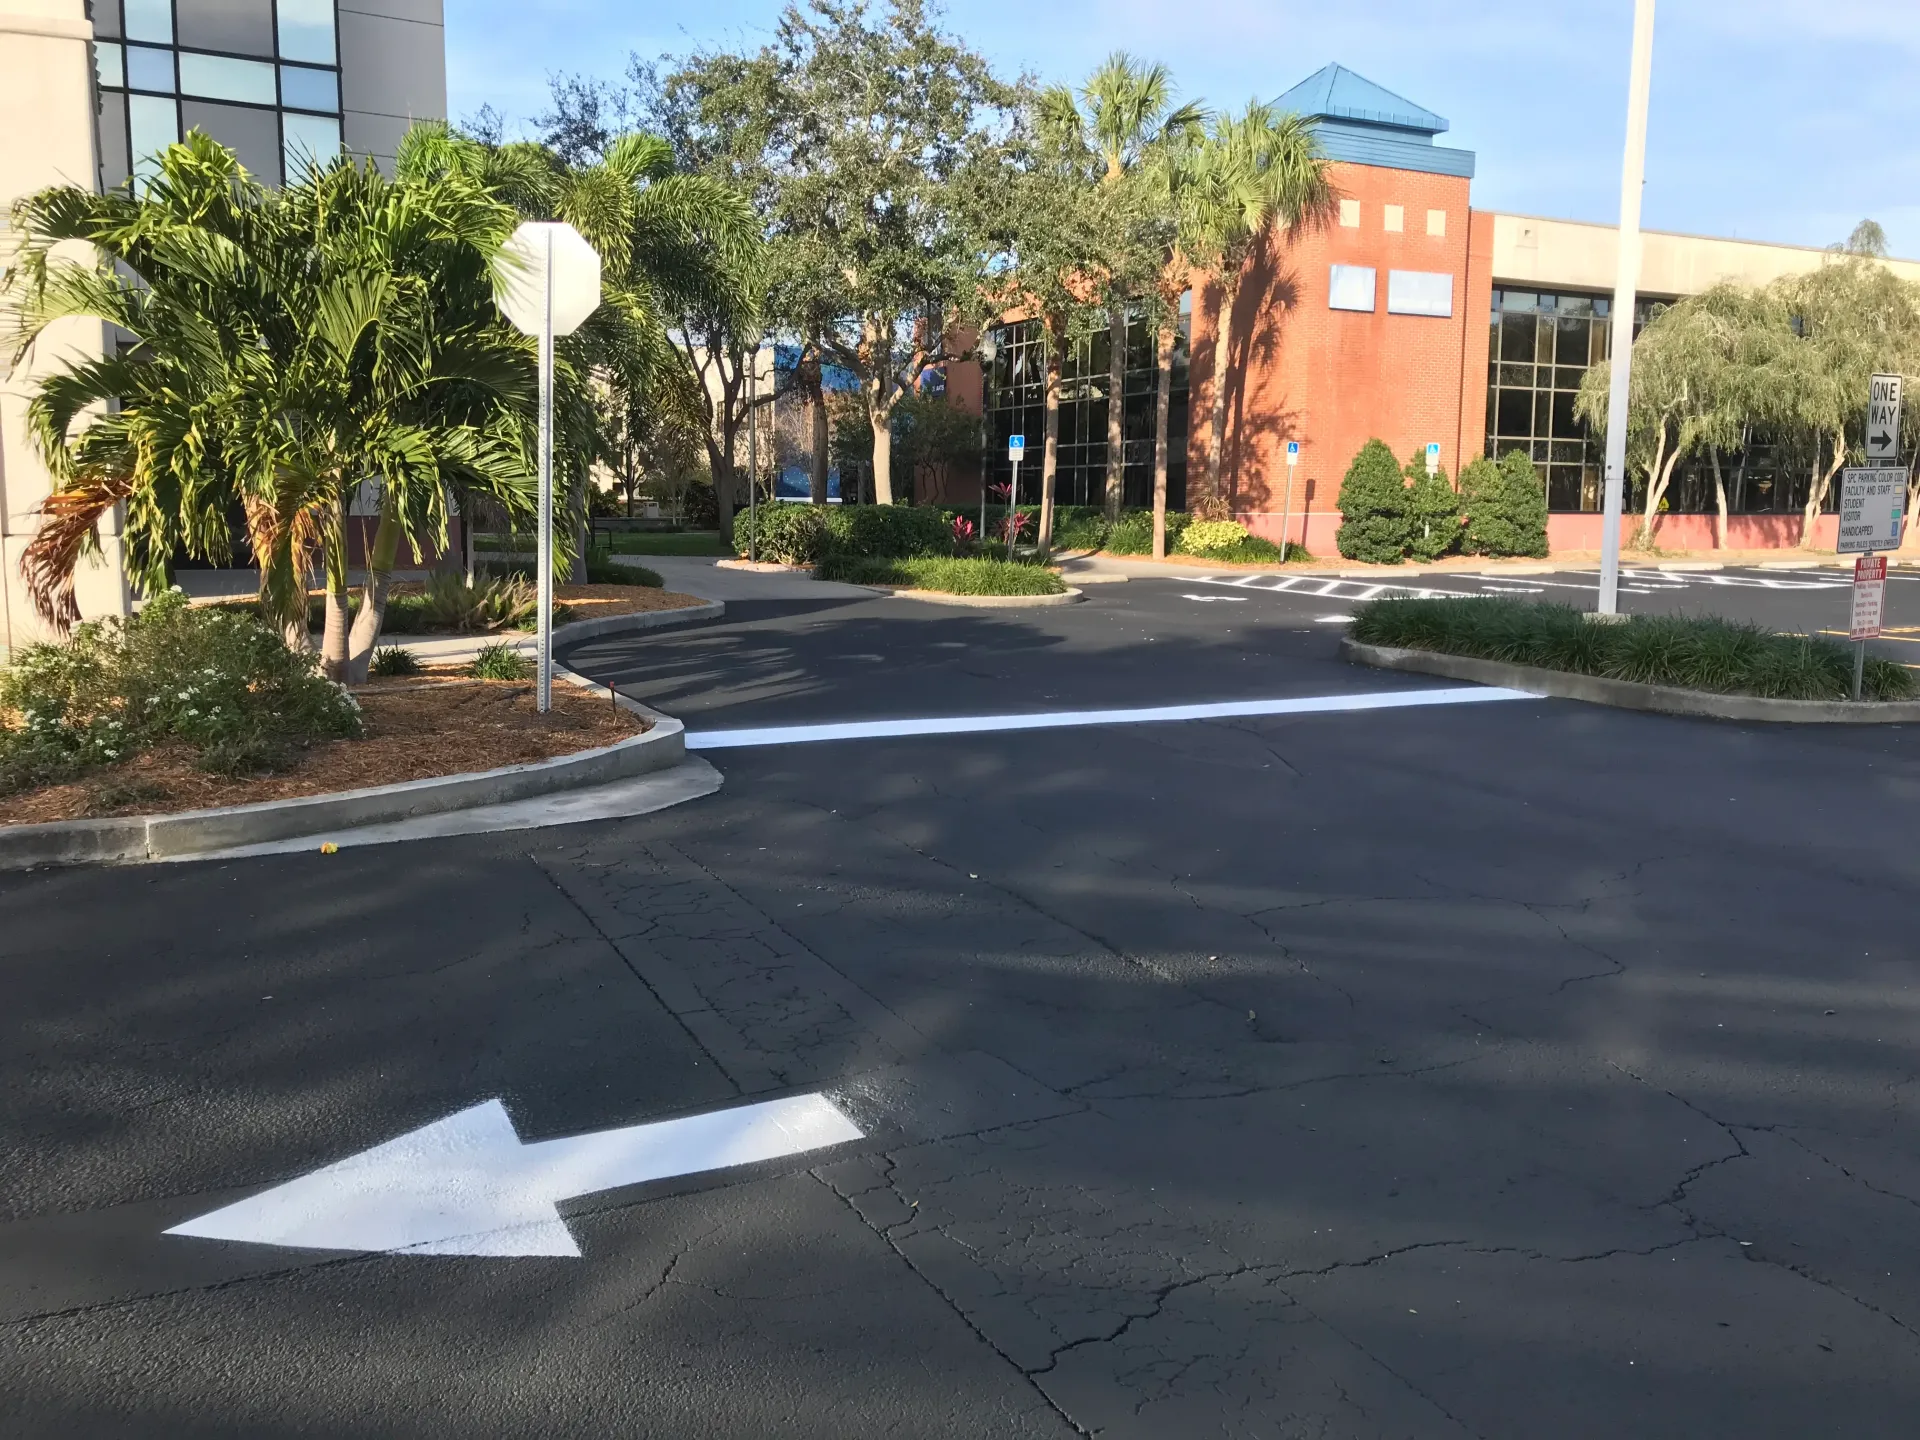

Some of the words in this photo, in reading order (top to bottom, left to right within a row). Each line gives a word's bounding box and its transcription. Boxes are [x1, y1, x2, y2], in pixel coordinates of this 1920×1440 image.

[1873, 381, 1897, 402] ONE
[1871, 405, 1896, 425] WAY
[1847, 473, 1857, 483] SPC
[1858, 473, 1877, 483] PARKING
[1878, 472, 1893, 483] COLOR
[1894, 472, 1904, 482] CODE
[1844, 485, 1865, 496] FACULTY
[1866, 485, 1876, 495] AND
[1877, 484, 1891, 495] STAFF
[1843, 498, 1865, 509] STUDENT
[1843, 510, 1861, 521] VISITOR
[1841, 525, 1873, 536] HANDICAPPED
[1840, 541, 1856, 549] PARKING
[1860, 558, 1881, 569] PRIVATE
[1857, 569, 1883, 580] PROPERTY
